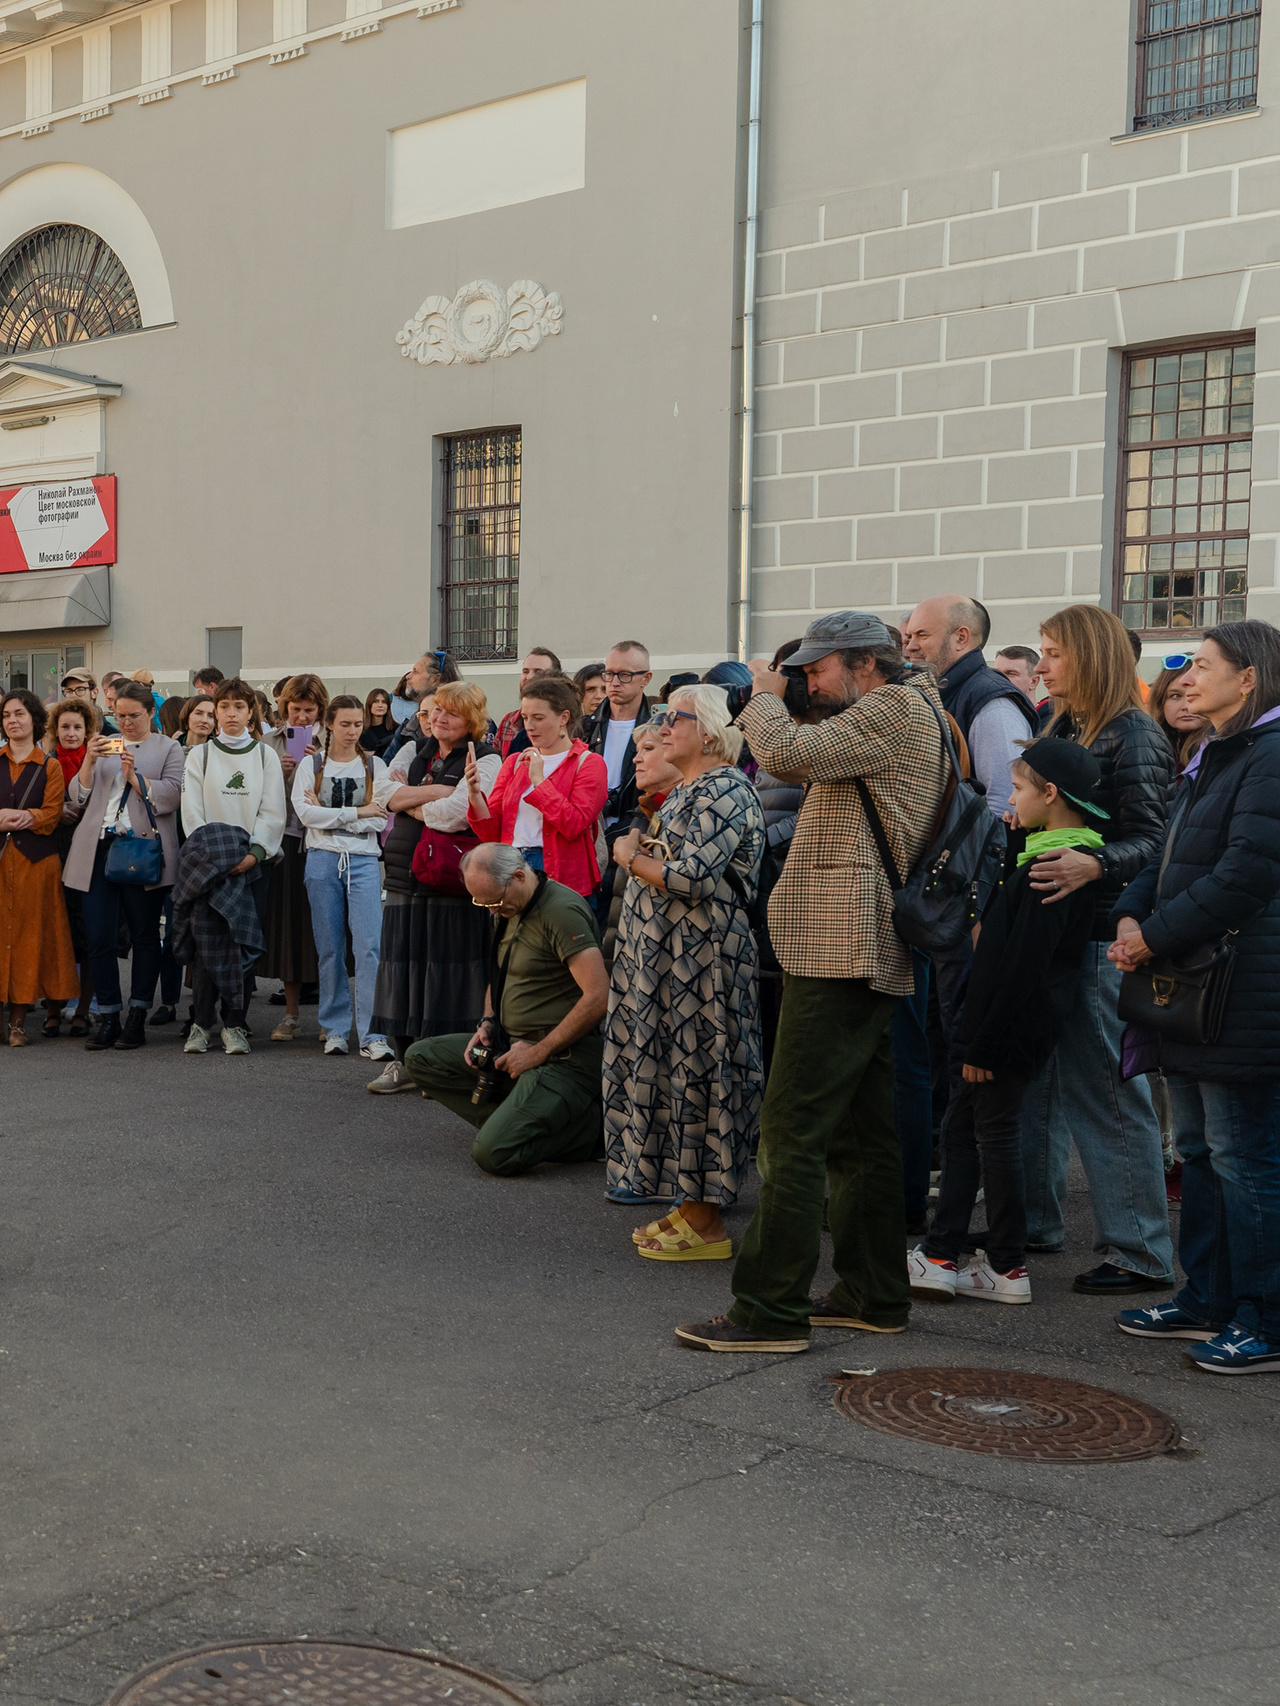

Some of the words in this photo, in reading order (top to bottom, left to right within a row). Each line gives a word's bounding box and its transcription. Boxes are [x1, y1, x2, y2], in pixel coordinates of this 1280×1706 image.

[38, 487, 66, 500] Николай
[68, 485, 103, 498] Рахманов.
[38, 501, 54, 513] Цвет
[56, 495, 96, 510] московской
[38, 510, 79, 525] фотографии
[38, 552, 64, 563] Москва
[65, 550, 77, 561] без
[78, 549, 102, 561] окраин
